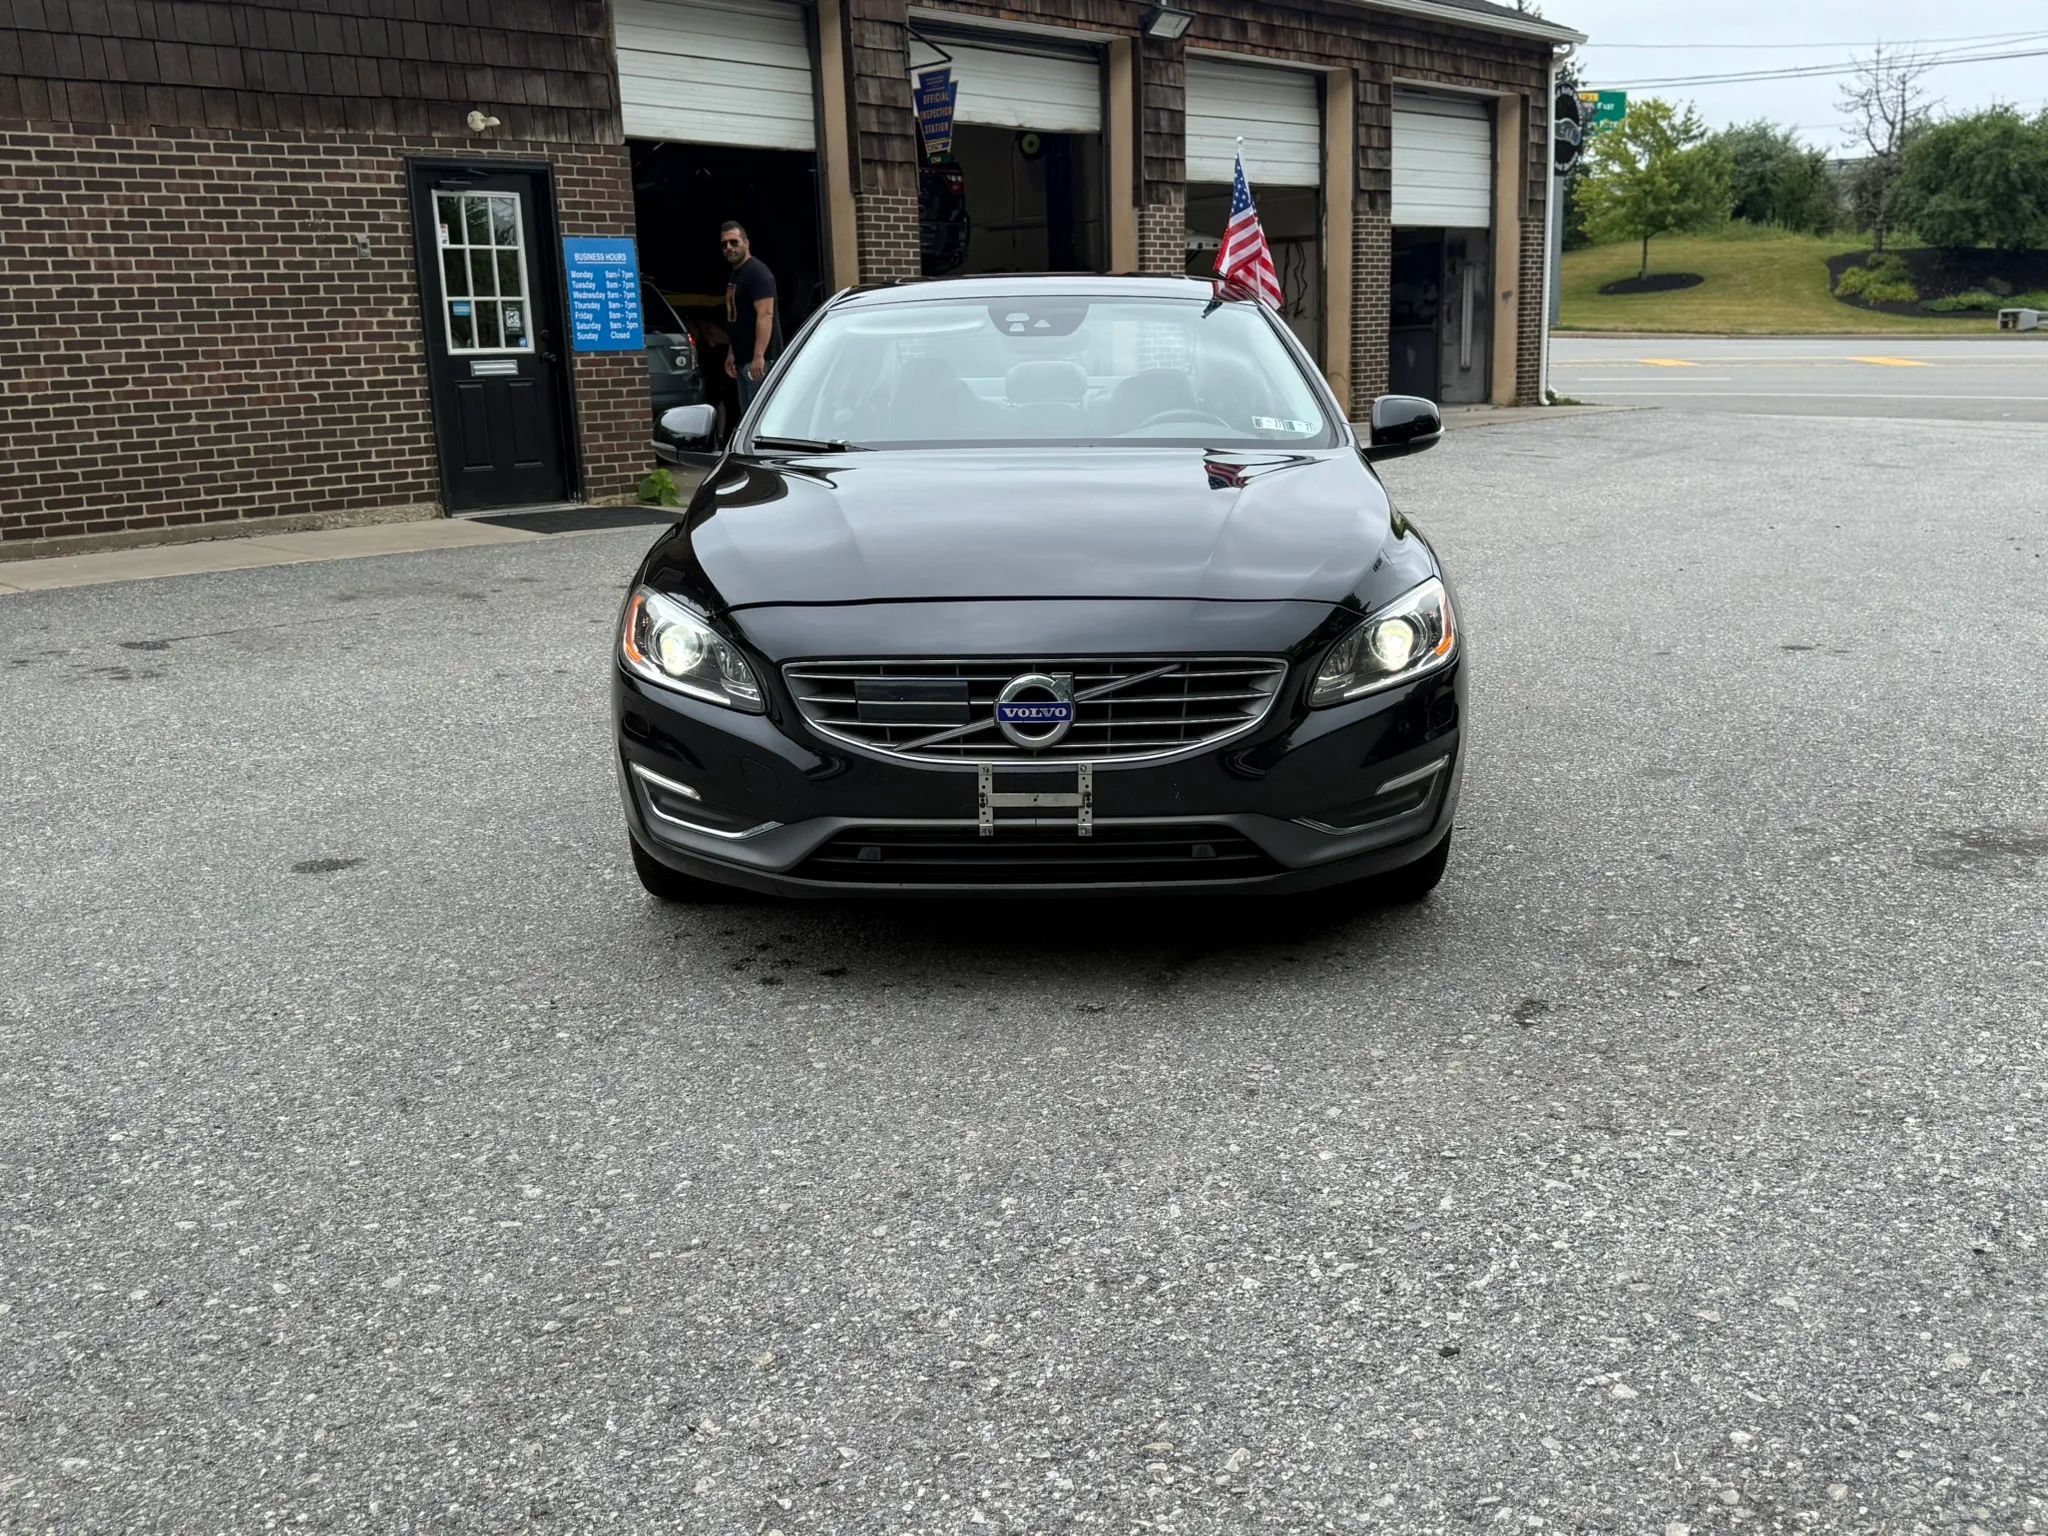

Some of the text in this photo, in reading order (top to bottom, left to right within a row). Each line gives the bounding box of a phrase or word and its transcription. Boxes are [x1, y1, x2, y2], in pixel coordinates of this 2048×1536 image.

[923, 91, 949, 105] OFFICIAL
[920, 106, 953, 120] INSPECTION
[924, 121, 949, 134] STATION
[574, 252, 627, 261] BUSINESS HOURS
[571, 270, 593, 280] Monday
[572, 281, 596, 290] Tuesday
[573, 291, 605, 300] Wednesday
[574, 301, 600, 310] Thursday
[575, 311, 593, 321] Friday
[576, 321, 601, 331] Saturday
[577, 331, 631, 341] Sunday Closed
[1002, 707, 1067, 718] VOLVO
